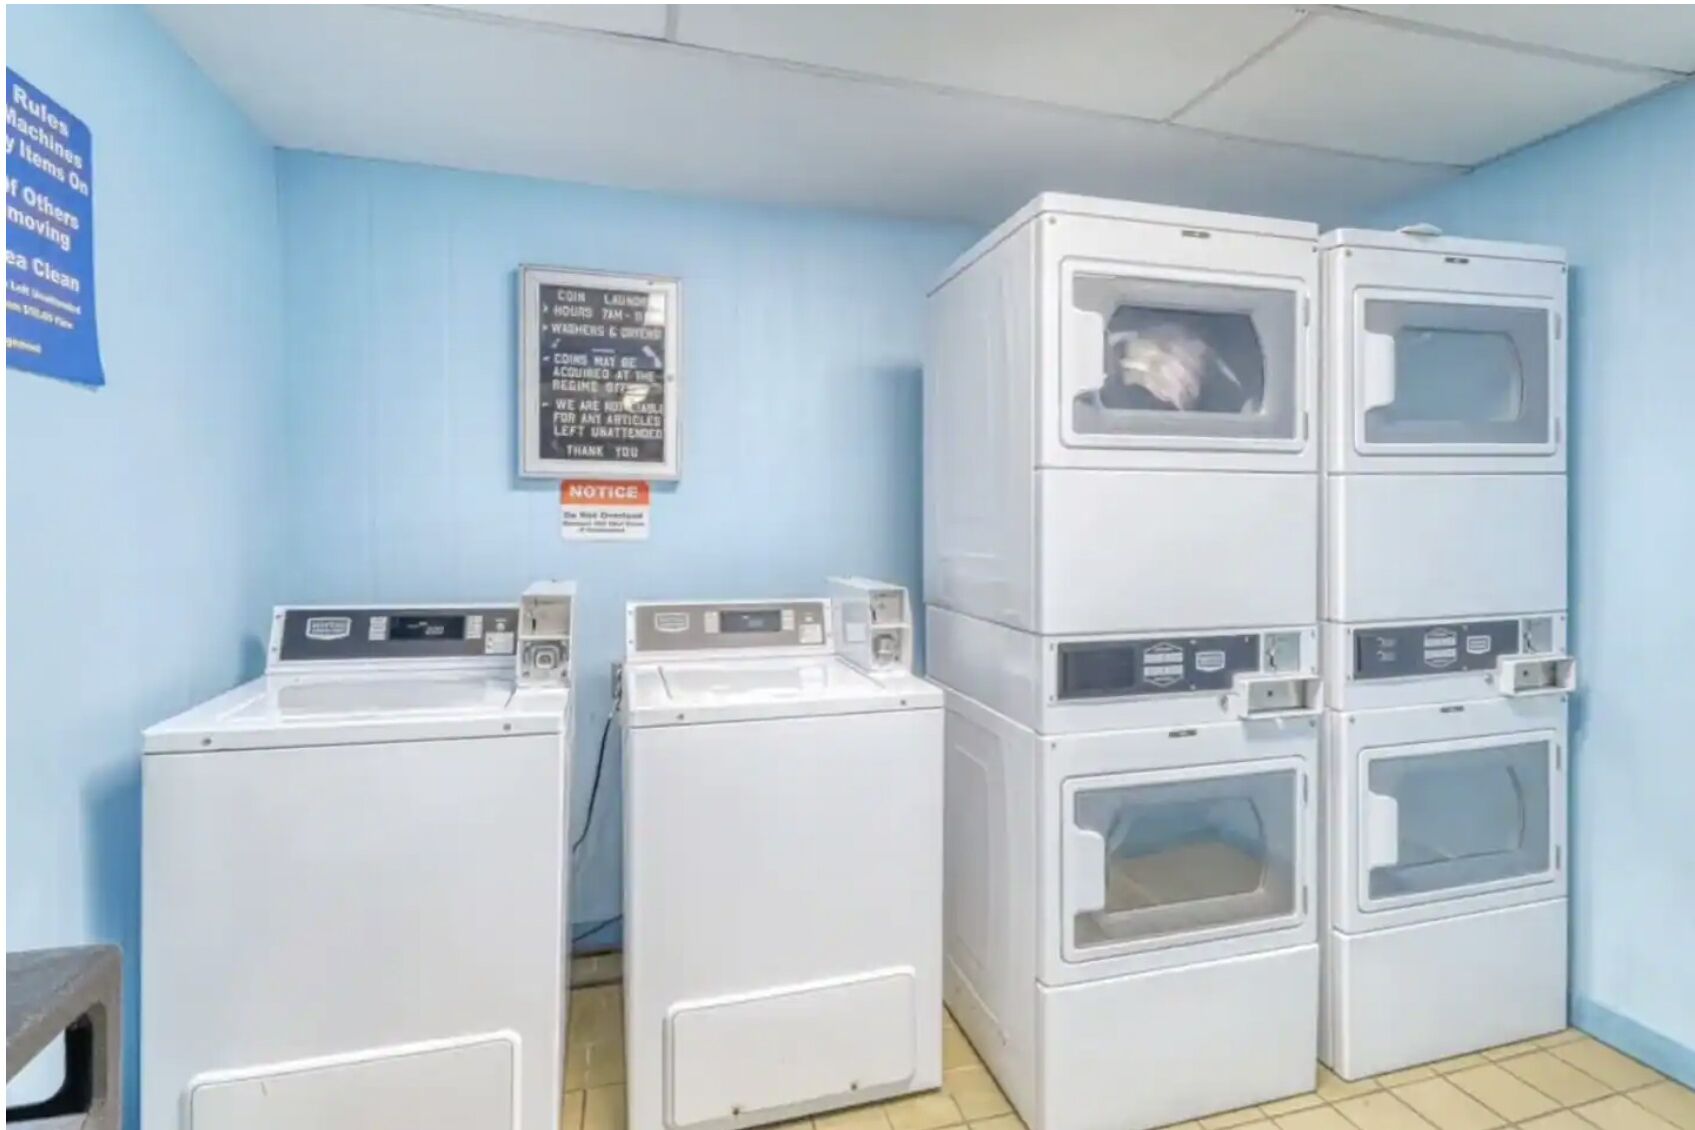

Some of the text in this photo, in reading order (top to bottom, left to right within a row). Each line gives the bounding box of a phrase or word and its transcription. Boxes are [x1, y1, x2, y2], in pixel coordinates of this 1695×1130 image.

[12, 83, 69, 137] Rules
[19, 139, 66, 183] Items
[69, 170, 89, 196] On
[22, 186, 79, 229] Others
[6, 205, 70, 251] moving
[6, 249, 80, 292] ea Clean
[557, 289, 586, 303] COIN
[553, 305, 593, 319] HOURS
[551, 323, 605, 337] WASHERS
[553, 353, 638, 369] COINS MAY BE
[552, 367, 656, 383] ACQUIRED AT THE
[555, 399, 575, 411] WE
[579, 400, 600, 412] ARE
[553, 411, 661, 427] FOR ANY ARTICLES
[553, 424, 663, 439] LEFT UNATTENDED
[566, 444, 639, 459] THANK YOU
[569, 484, 638, 499] NOTICE
